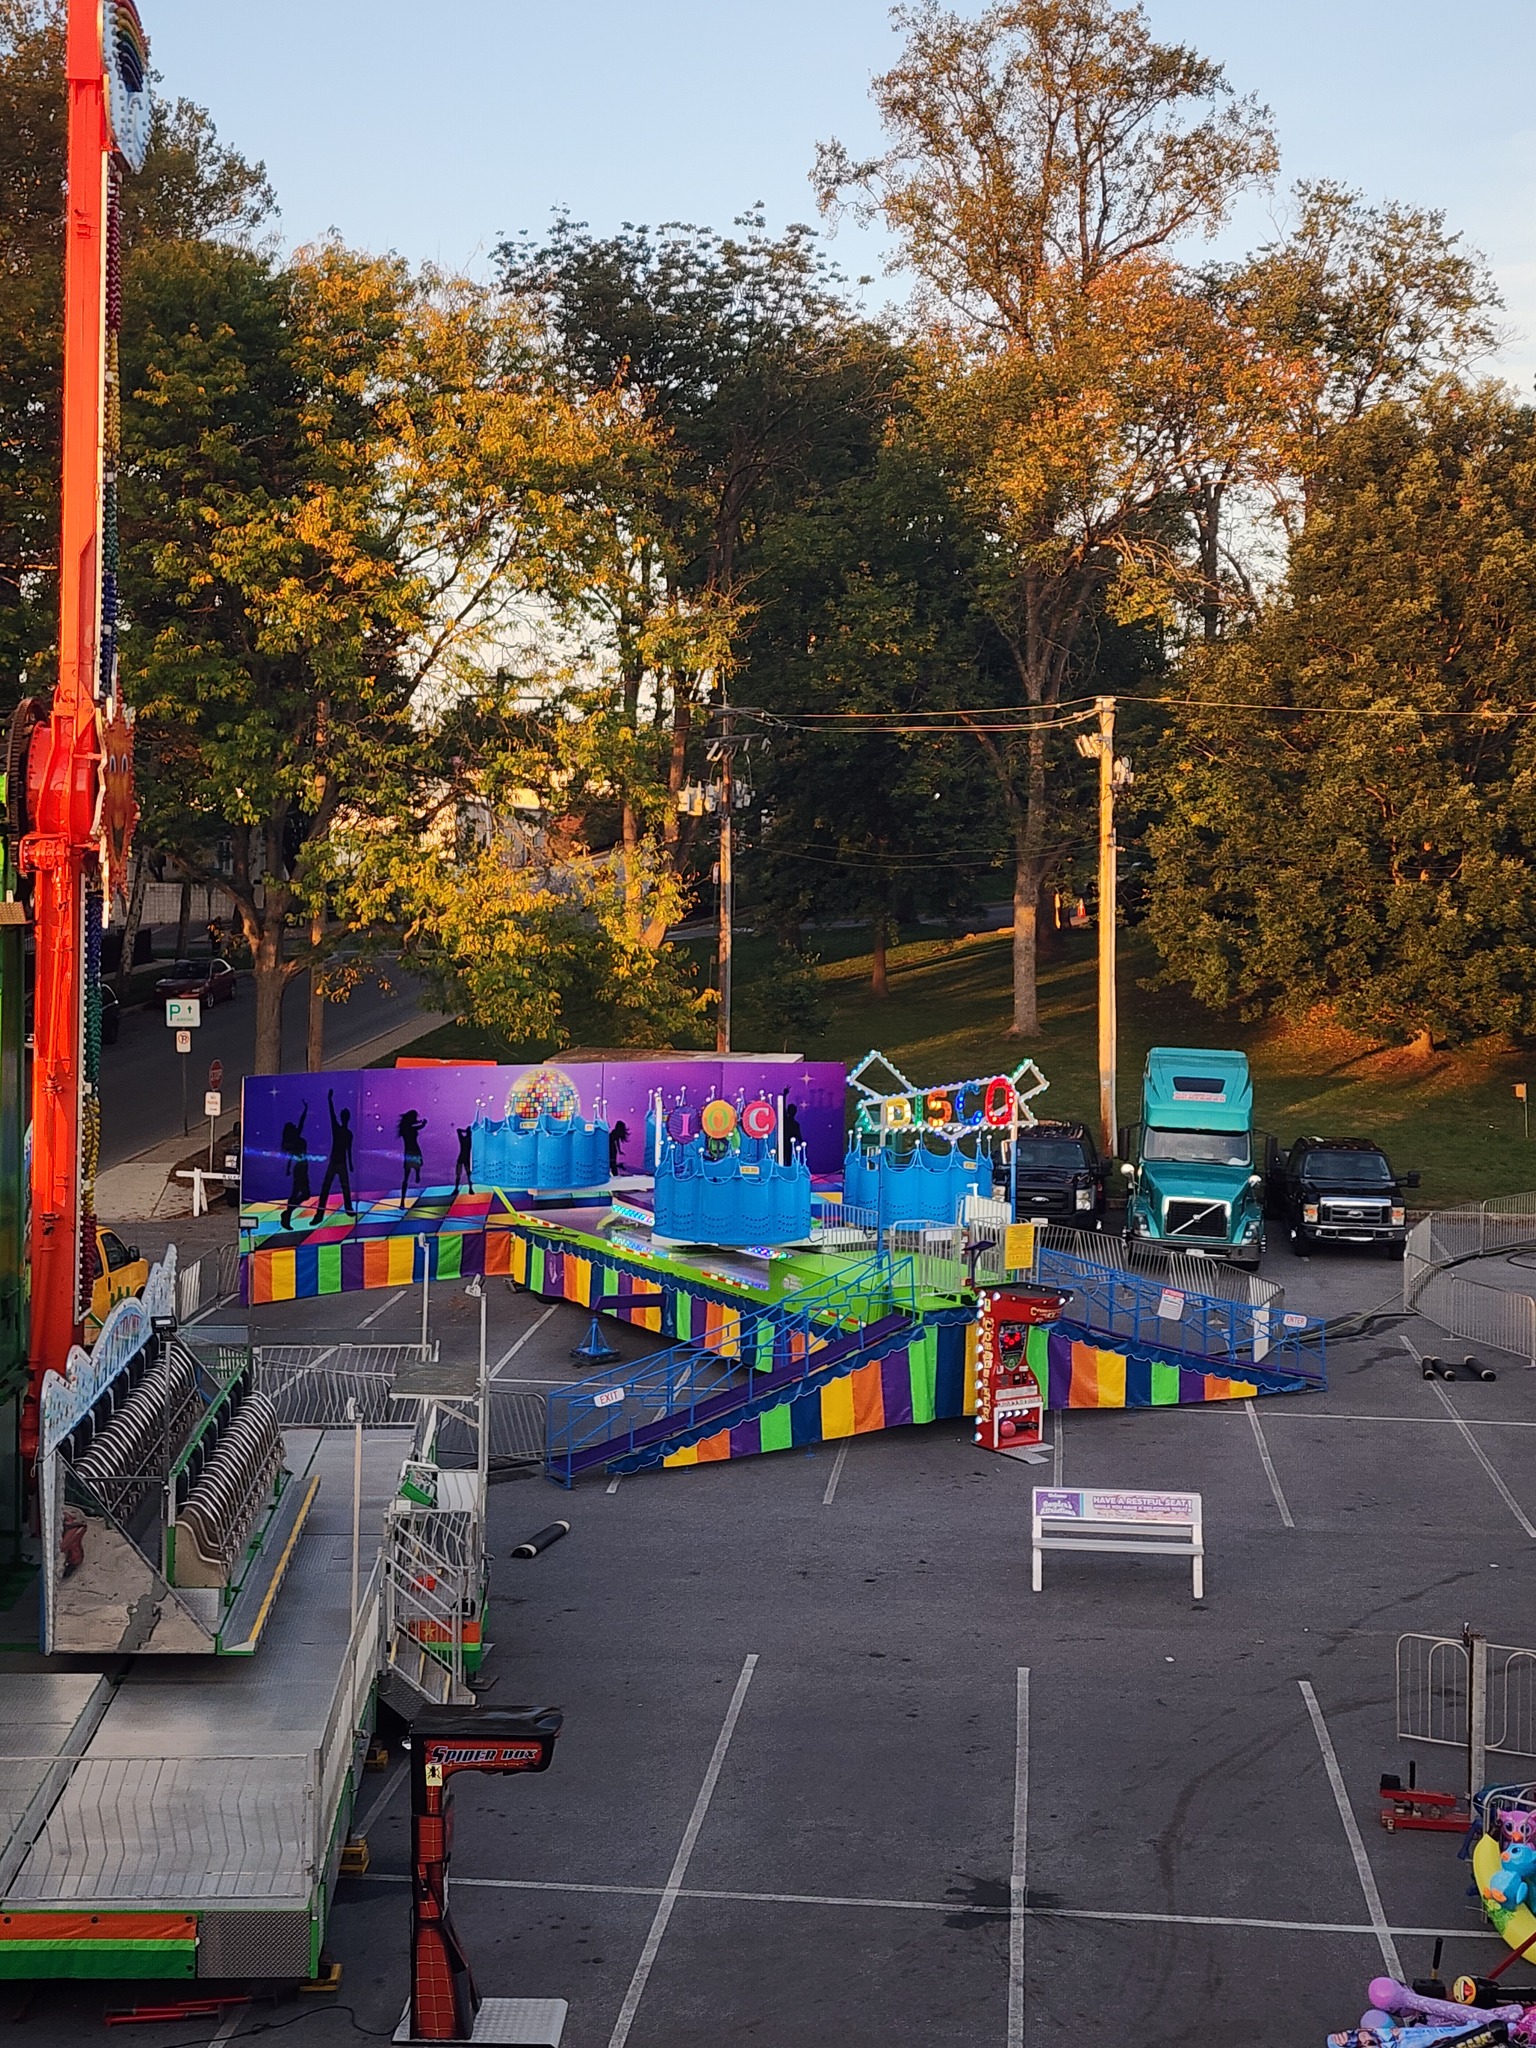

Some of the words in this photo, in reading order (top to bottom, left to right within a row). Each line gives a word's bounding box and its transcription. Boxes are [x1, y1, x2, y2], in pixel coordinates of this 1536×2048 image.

[885, 1077, 1014, 1128] DISCO
[1286, 1315, 1305, 1325] ENTER
[600, 1391, 618, 1404] EXIT
[1126, 1497, 1163, 1505] RESTFUL
[429, 1746, 497, 1765] SPIDER
[502, 1749, 537, 1760] BOX
